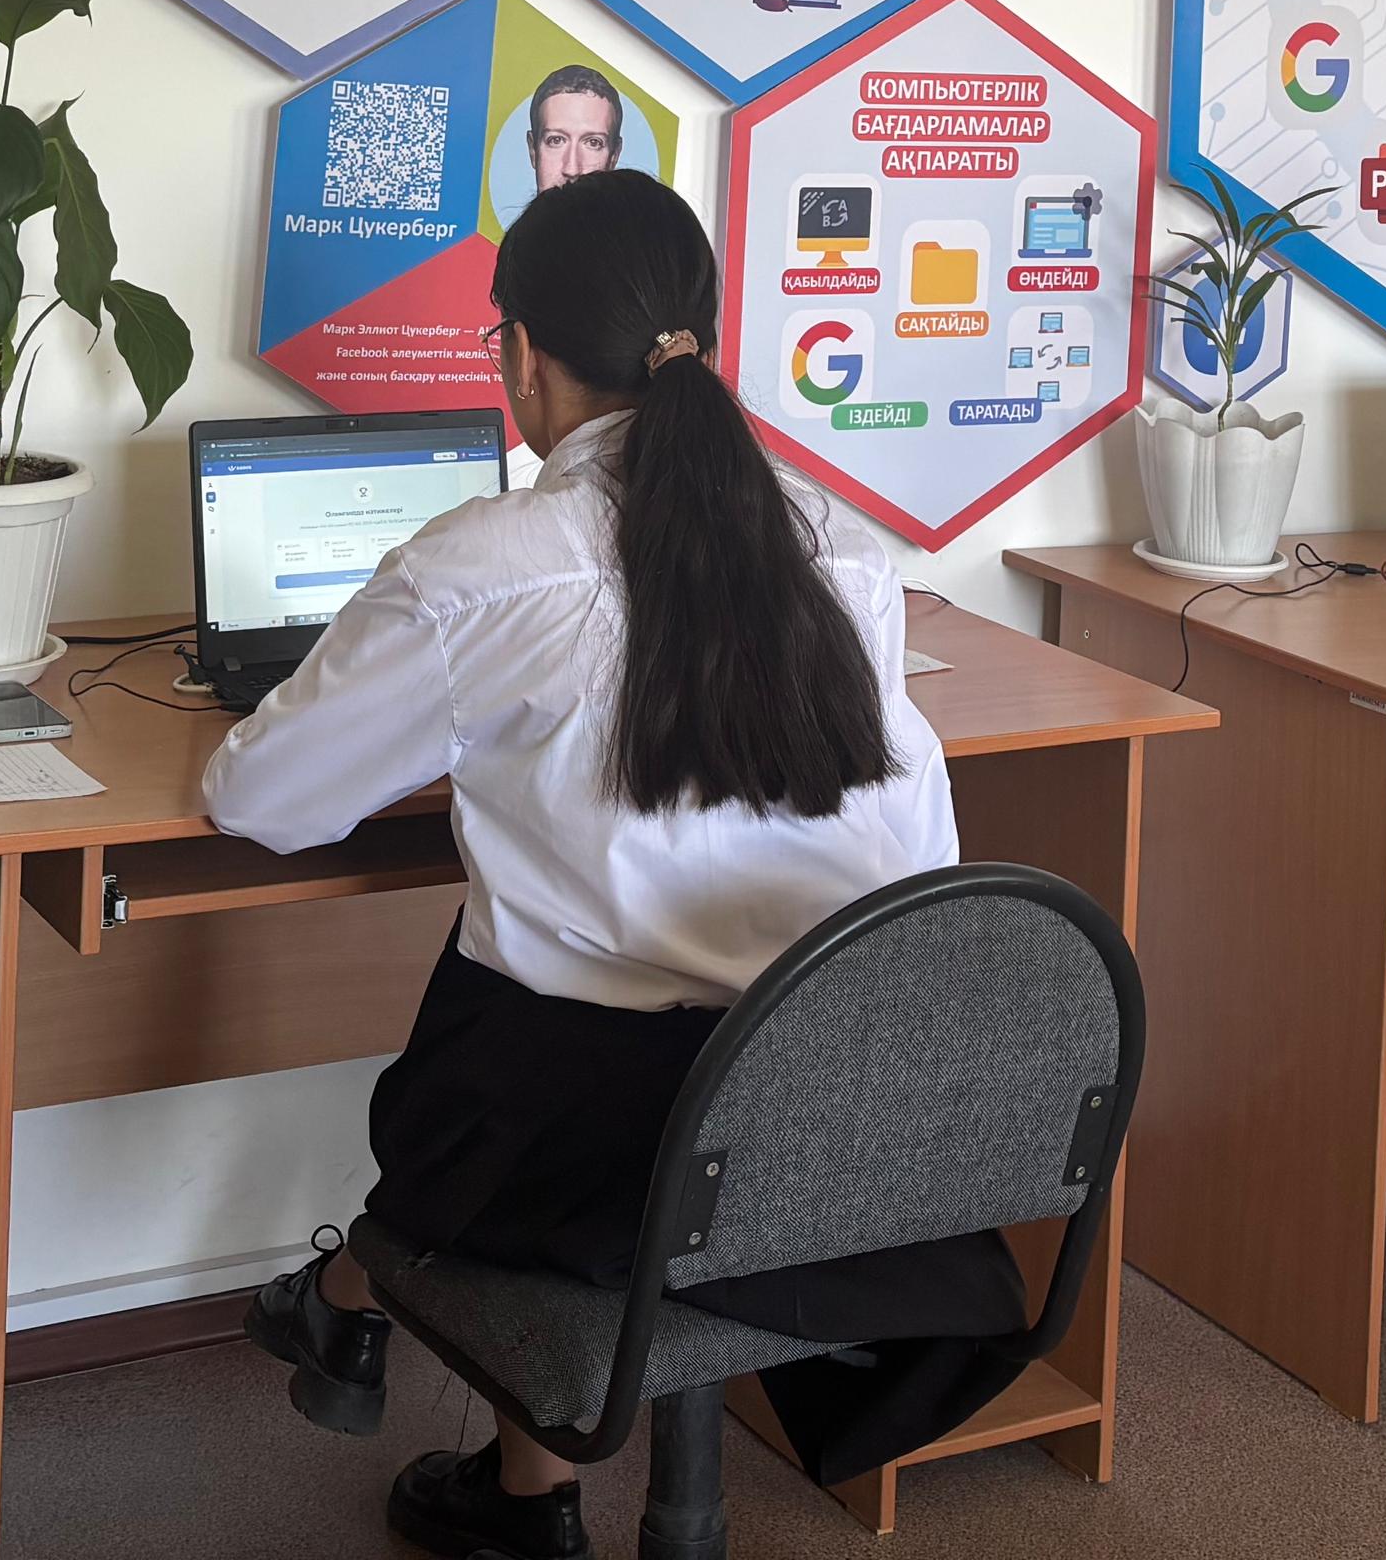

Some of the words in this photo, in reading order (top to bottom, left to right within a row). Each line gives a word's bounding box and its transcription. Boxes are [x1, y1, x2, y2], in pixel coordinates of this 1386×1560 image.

[1280, 22, 1350, 112] G
[867, 77, 1040, 102] КОМПЬЮТЕРЛІК
[857, 114, 1046, 139] БАҒДАРЛАМАЛАР
[886, 151, 1013, 175] АҚПАРАТТЫ
[284, 215, 342, 236] Марк
[348, 216, 457, 242] Цукерберг
[784, 272, 878, 291] ҚАБЫЛДАЙДЫ
[1019, 270, 1088, 292] ӨҢДЕЙДІ
[323, 324, 355, 336] Марк
[358, 325, 398, 335] Эллиот
[401, 326, 461, 338] Цукерберг
[899, 315, 984, 334] САҚТАЙДЫ
[337, 348, 388, 358] Facebook
[392, 348, 452, 361] әлеуметтік
[792, 320, 863, 405] G
[316, 372, 347, 381] және
[350, 373, 388, 383] соның
[391, 371, 435, 383] басқару
[438, 372, 490, 383] кеңесінің
[849, 405, 911, 426] ІЗДЕЙДІ
[956, 403, 1035, 421] ТАРАТАДЫ
